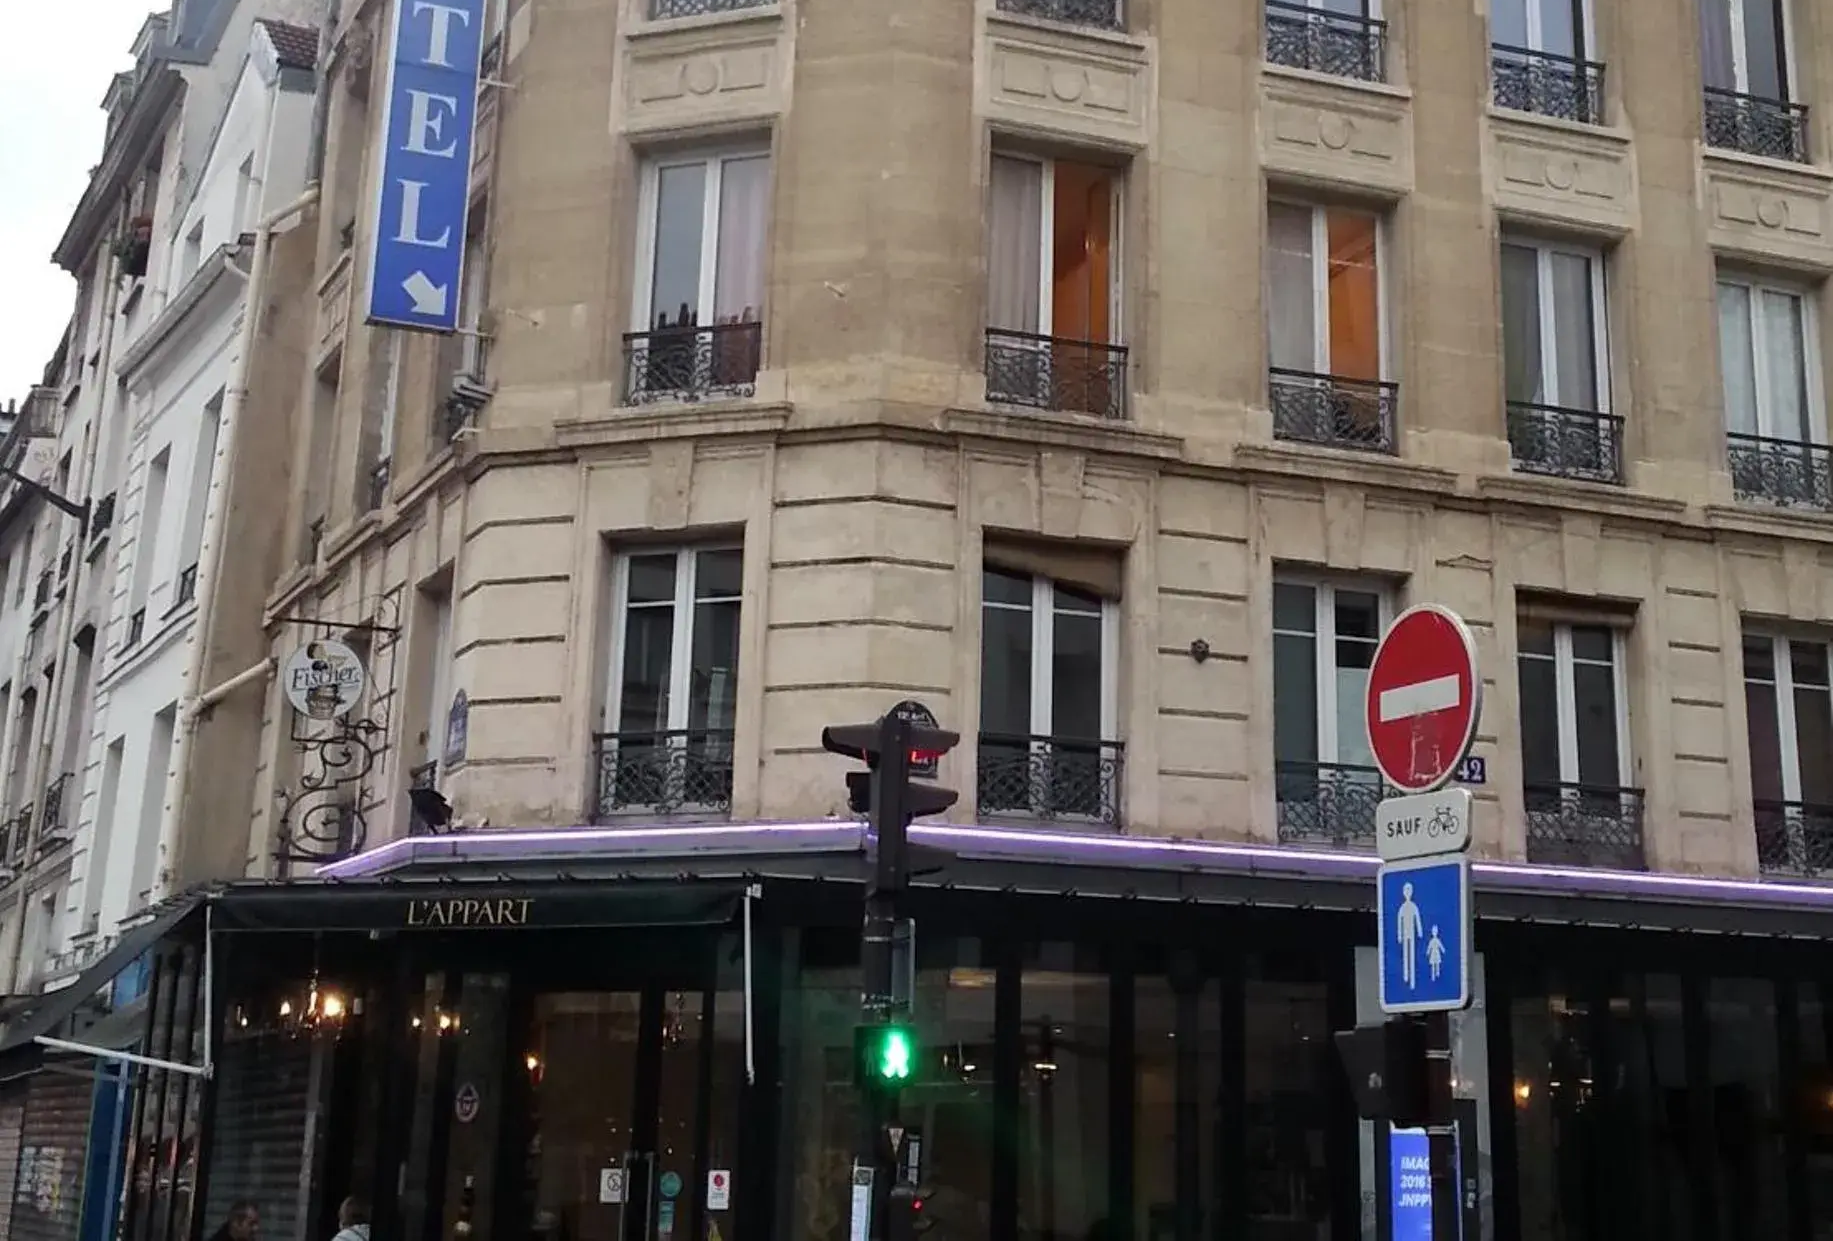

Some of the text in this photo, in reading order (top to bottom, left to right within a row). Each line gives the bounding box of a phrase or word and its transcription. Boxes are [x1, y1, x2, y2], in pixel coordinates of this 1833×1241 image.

[292, 662, 357, 689] Fischer
[1458, 759, 1482, 781] 42
[1387, 817, 1421, 838] SAUF
[408, 899, 536, 925] L'APPART
